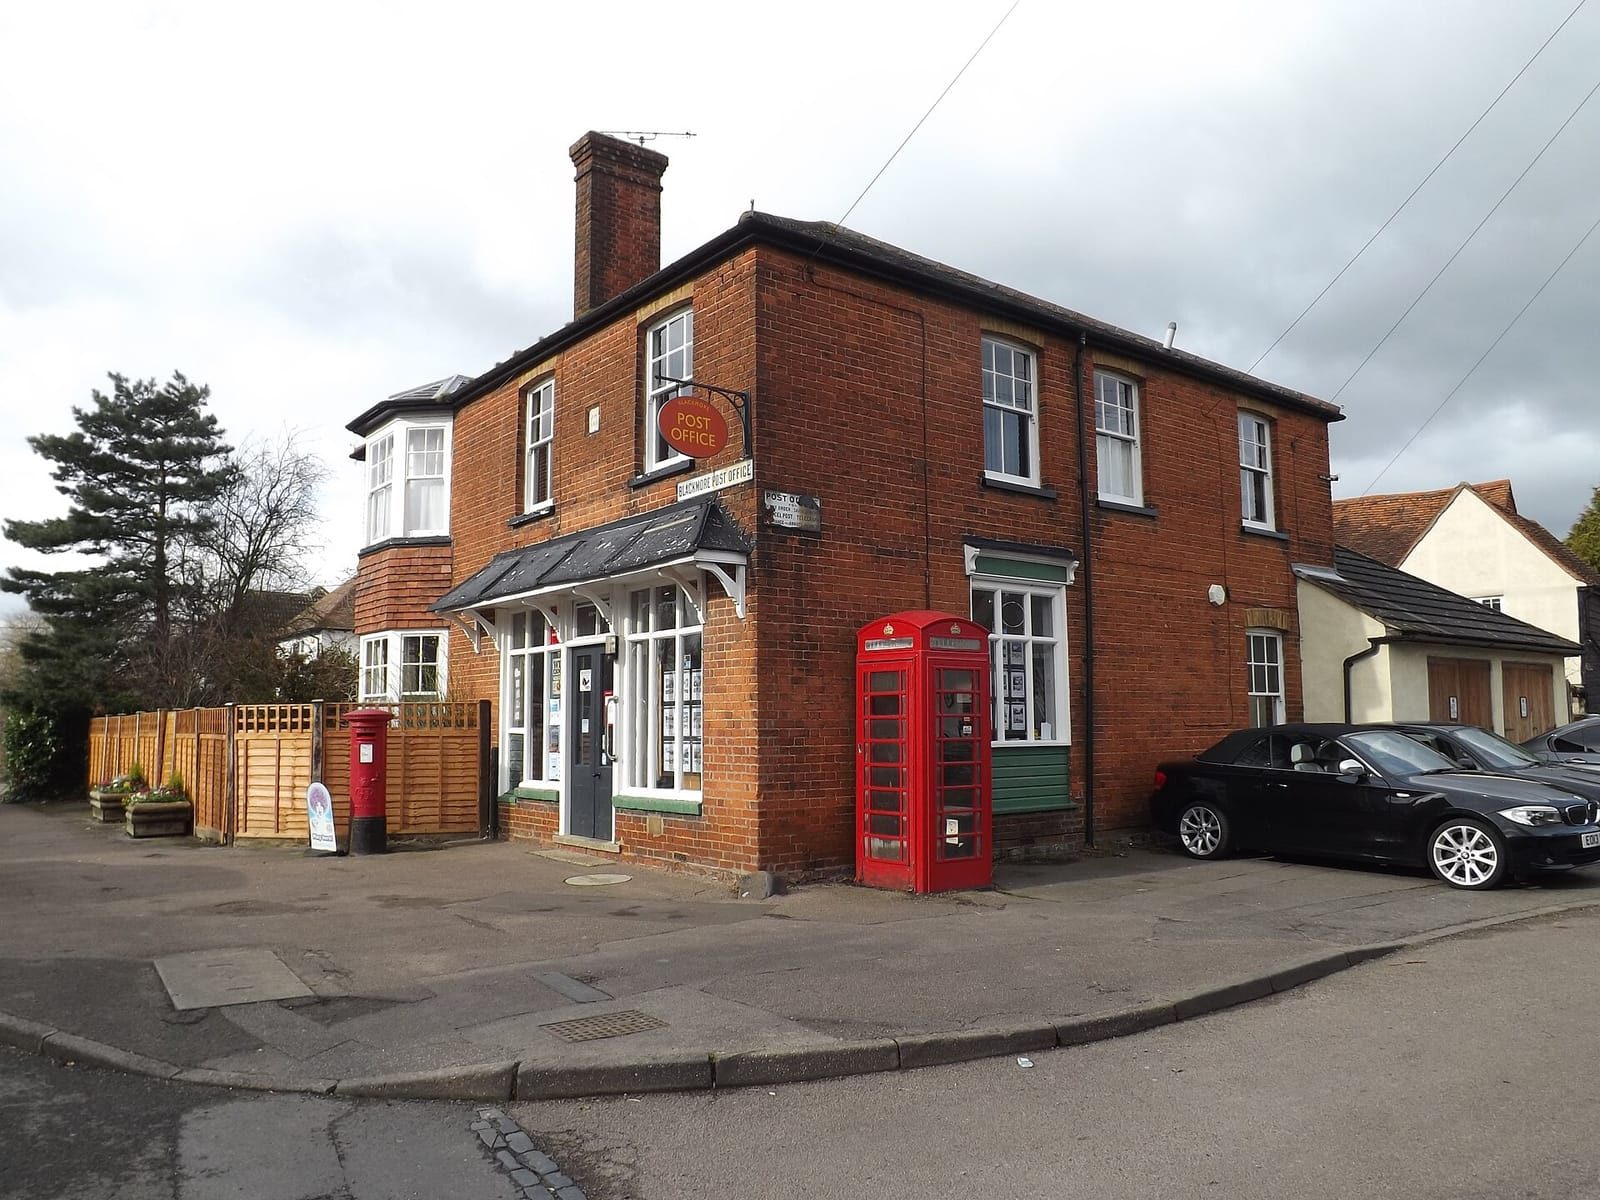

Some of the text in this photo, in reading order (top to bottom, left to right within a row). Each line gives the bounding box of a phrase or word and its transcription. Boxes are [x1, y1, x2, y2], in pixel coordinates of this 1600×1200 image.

[677, 412, 711, 430] POST
[671, 427, 716, 447] OFFICE
[679, 463, 751, 497] BLACKMORE POST OFFICE
[766, 492, 787, 502] POST
